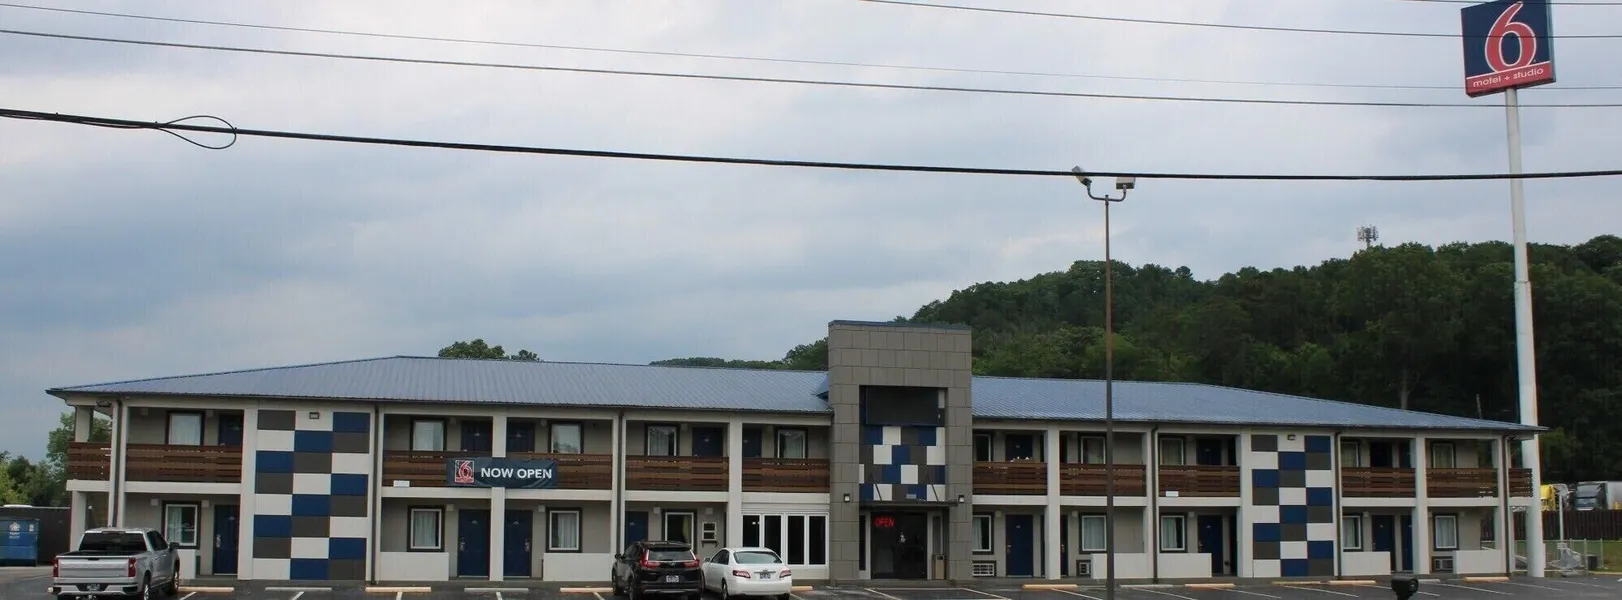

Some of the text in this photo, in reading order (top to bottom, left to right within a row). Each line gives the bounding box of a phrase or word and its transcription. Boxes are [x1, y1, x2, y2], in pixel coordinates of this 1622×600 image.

[1484, 1, 1537, 73] 6
[1473, 76, 1501, 88] motel
[1513, 67, 1544, 80] studio
[481, 468, 552, 479] NOW OPEN
[874, 517, 895, 527] OPEN
